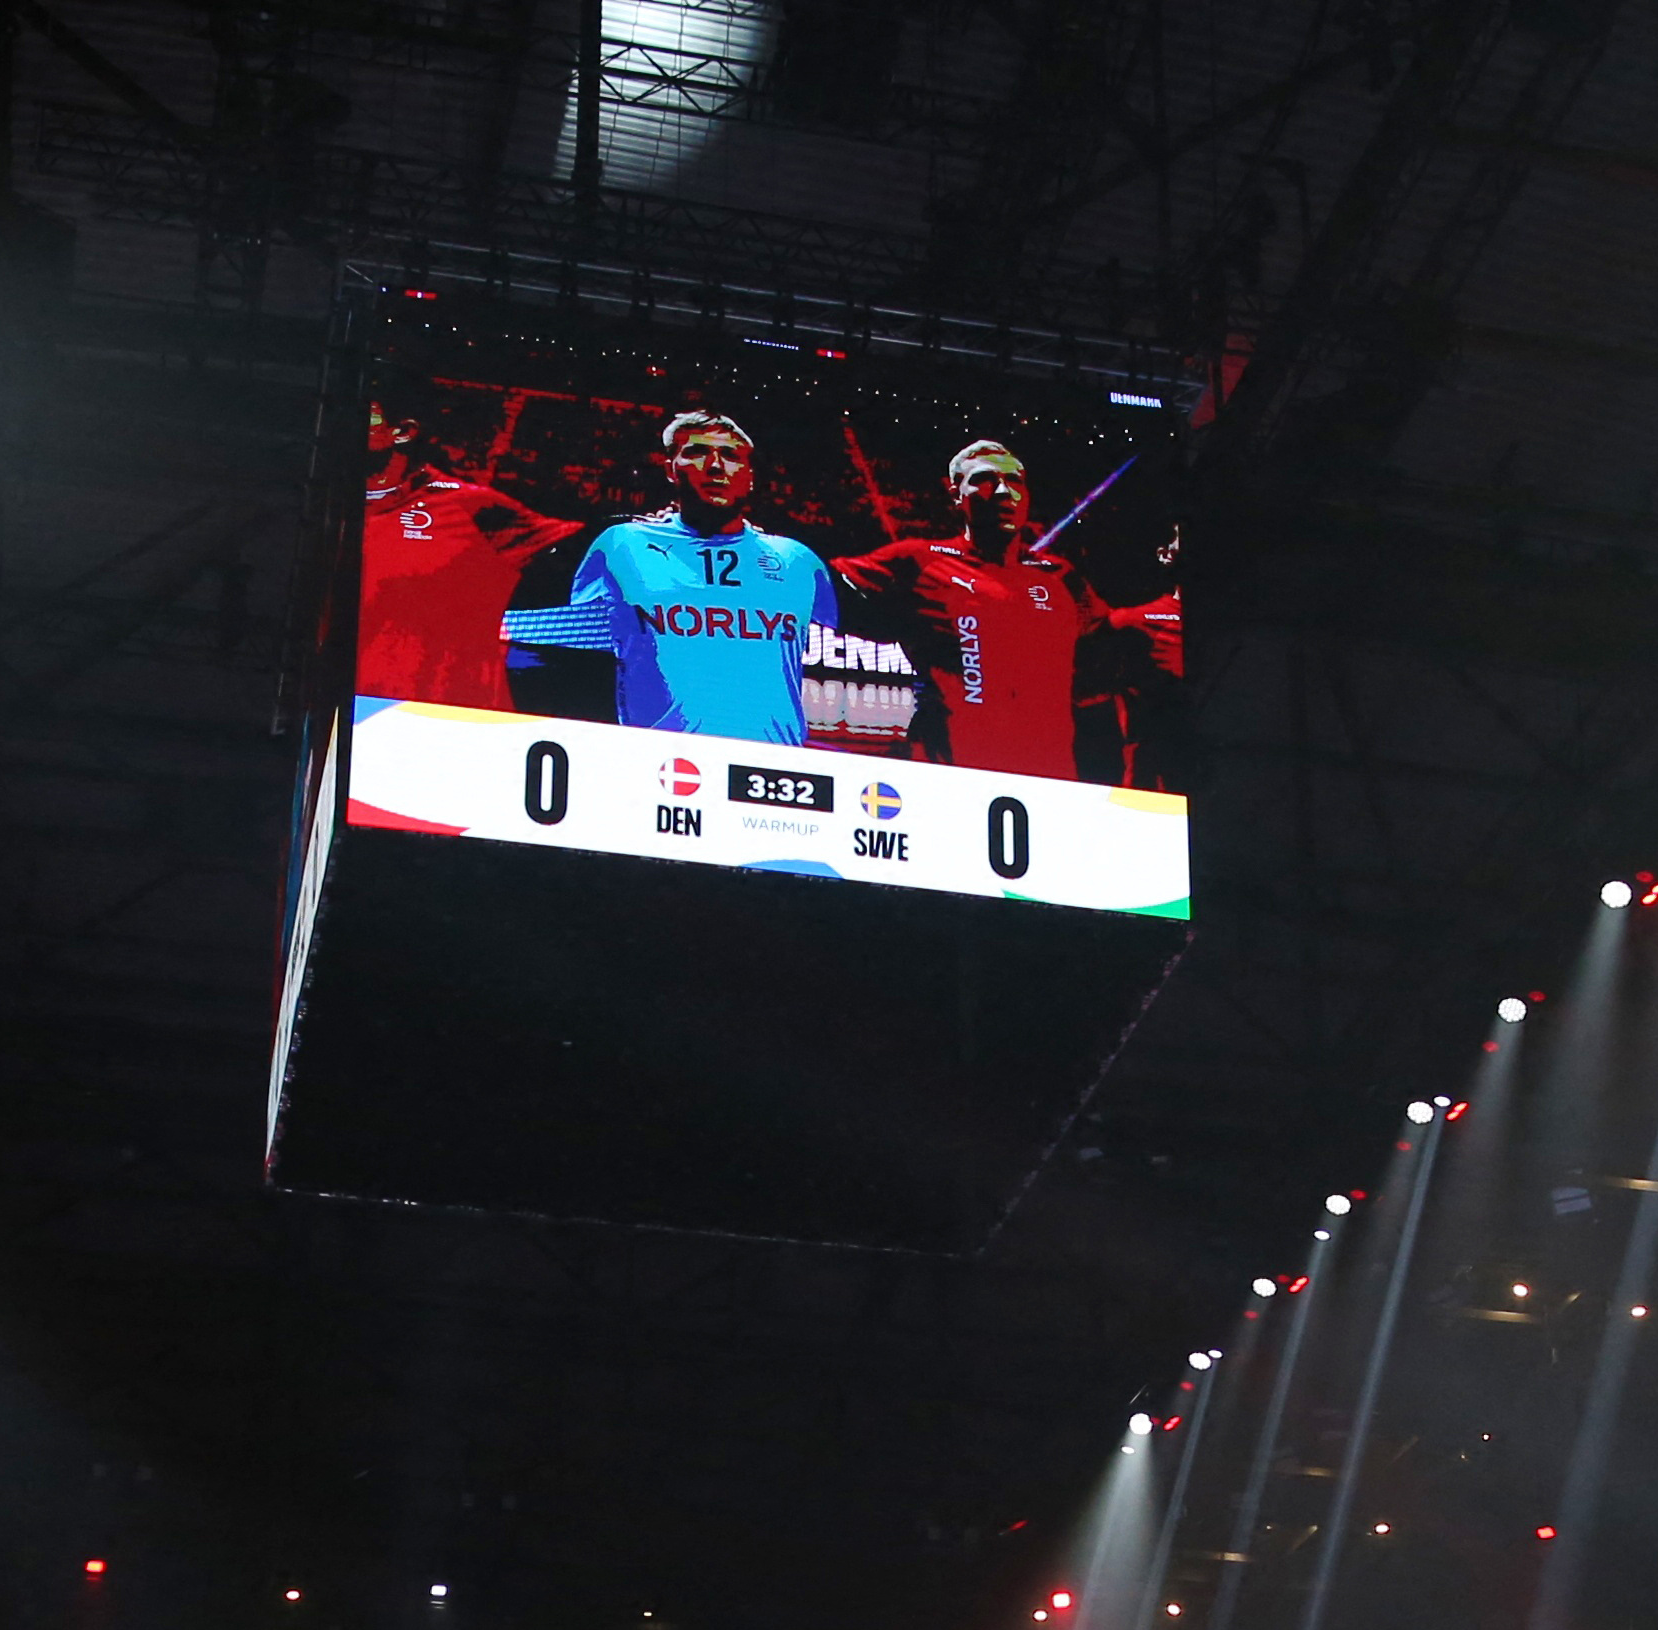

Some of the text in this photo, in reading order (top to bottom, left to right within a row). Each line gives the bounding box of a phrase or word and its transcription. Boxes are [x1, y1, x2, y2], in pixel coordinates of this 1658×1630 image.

[697, 549, 742, 587] 12
[635, 603, 799, 642] NORLYS
[957, 615, 984, 704] NORLYS
[523, 740, 570, 826] 0
[746, 772, 816, 806] 3:32
[656, 805, 703, 838] DEN
[741, 816, 821, 838] WARMUP
[987, 796, 1031, 880] 0
[853, 829, 910, 862] SWE
